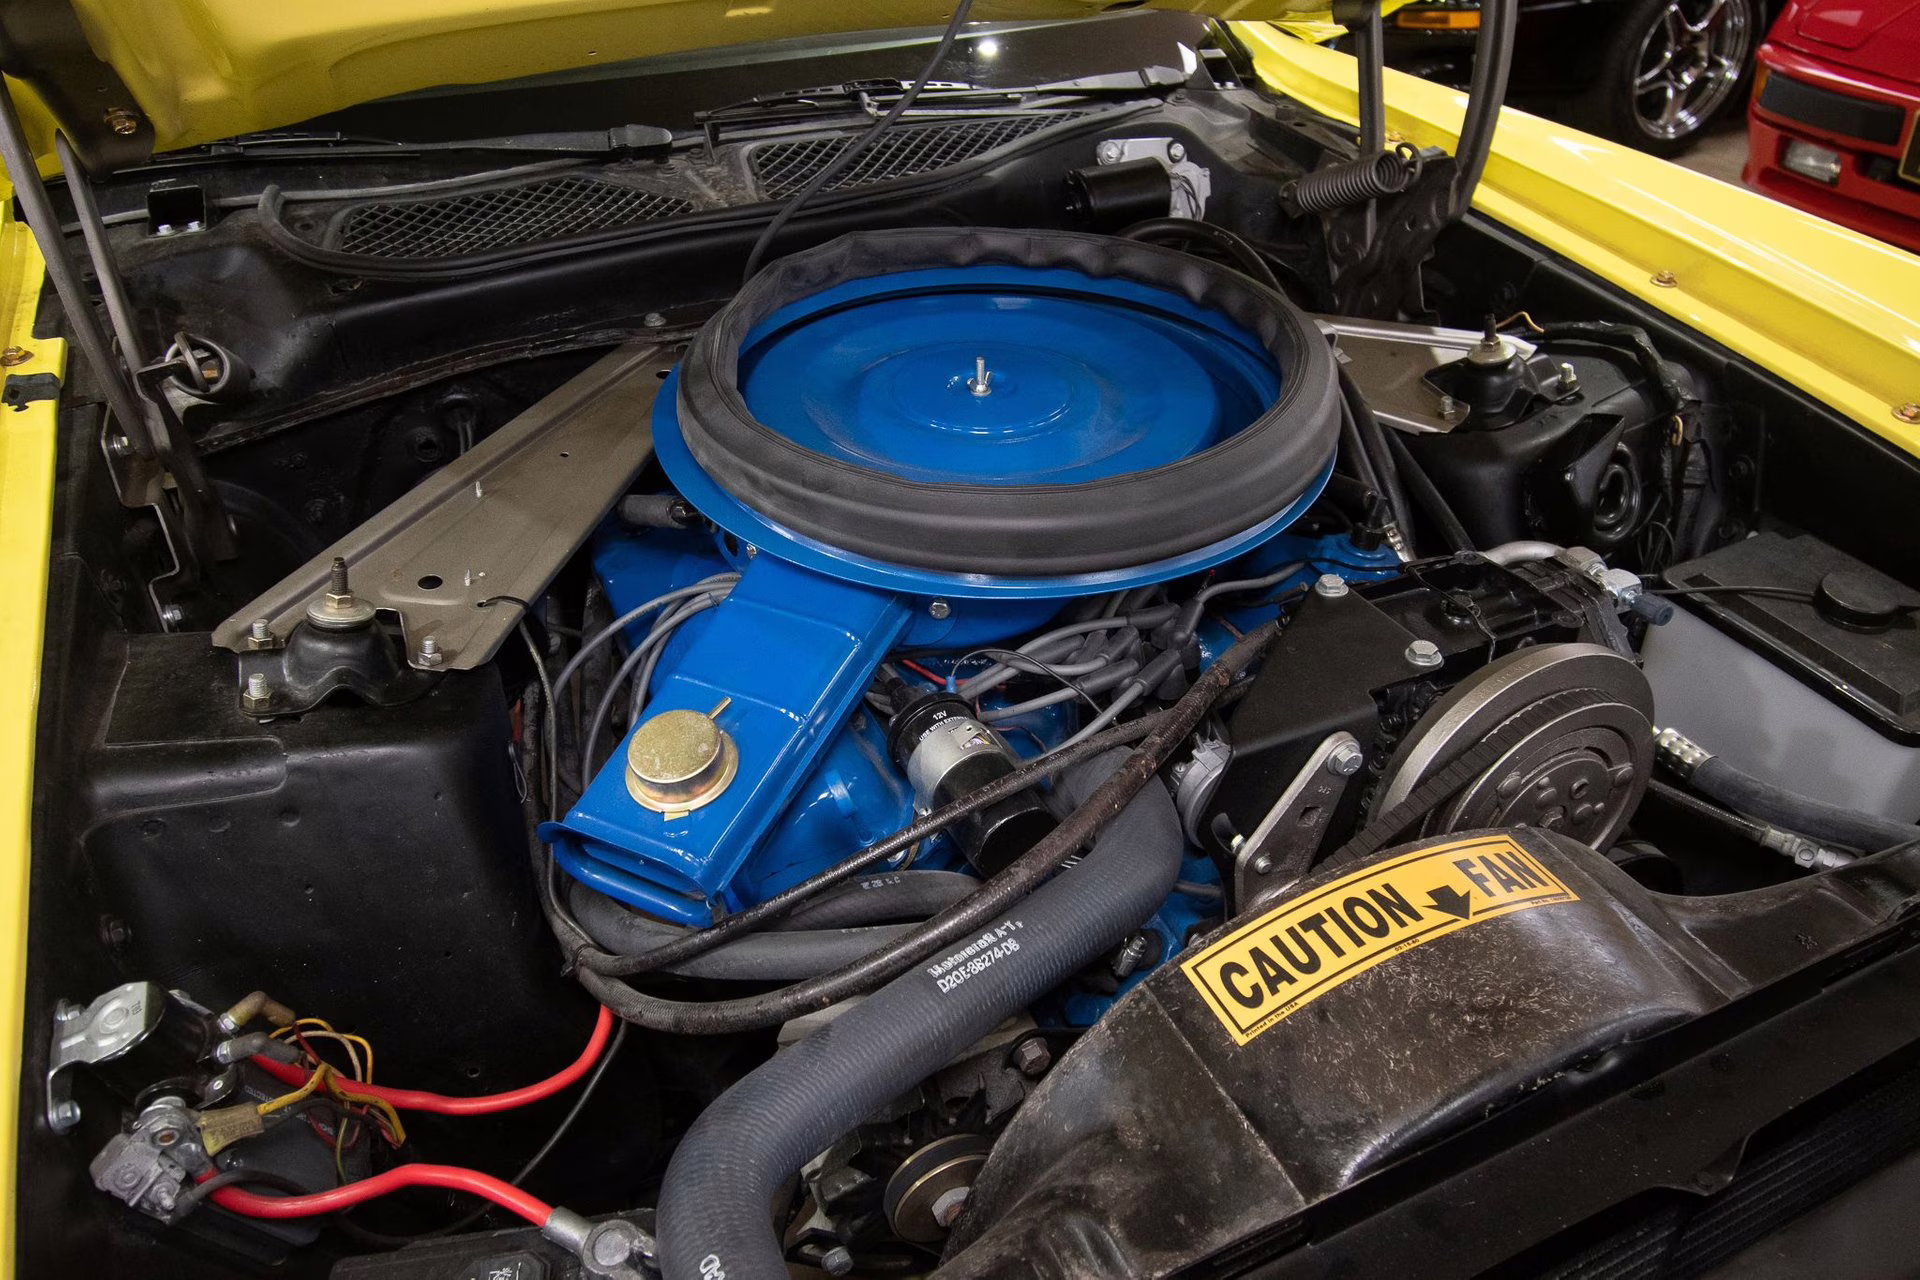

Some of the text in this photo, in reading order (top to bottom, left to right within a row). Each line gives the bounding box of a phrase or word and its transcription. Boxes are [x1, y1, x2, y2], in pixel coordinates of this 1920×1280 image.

[929, 720, 944, 732] WITH
[932, 710, 947, 720] 12V
[1219, 850, 1547, 1009] CAUTION FAN
[1245, 1021, 1267, 1038] Printed
[1285, 1002, 1299, 1011] USA
